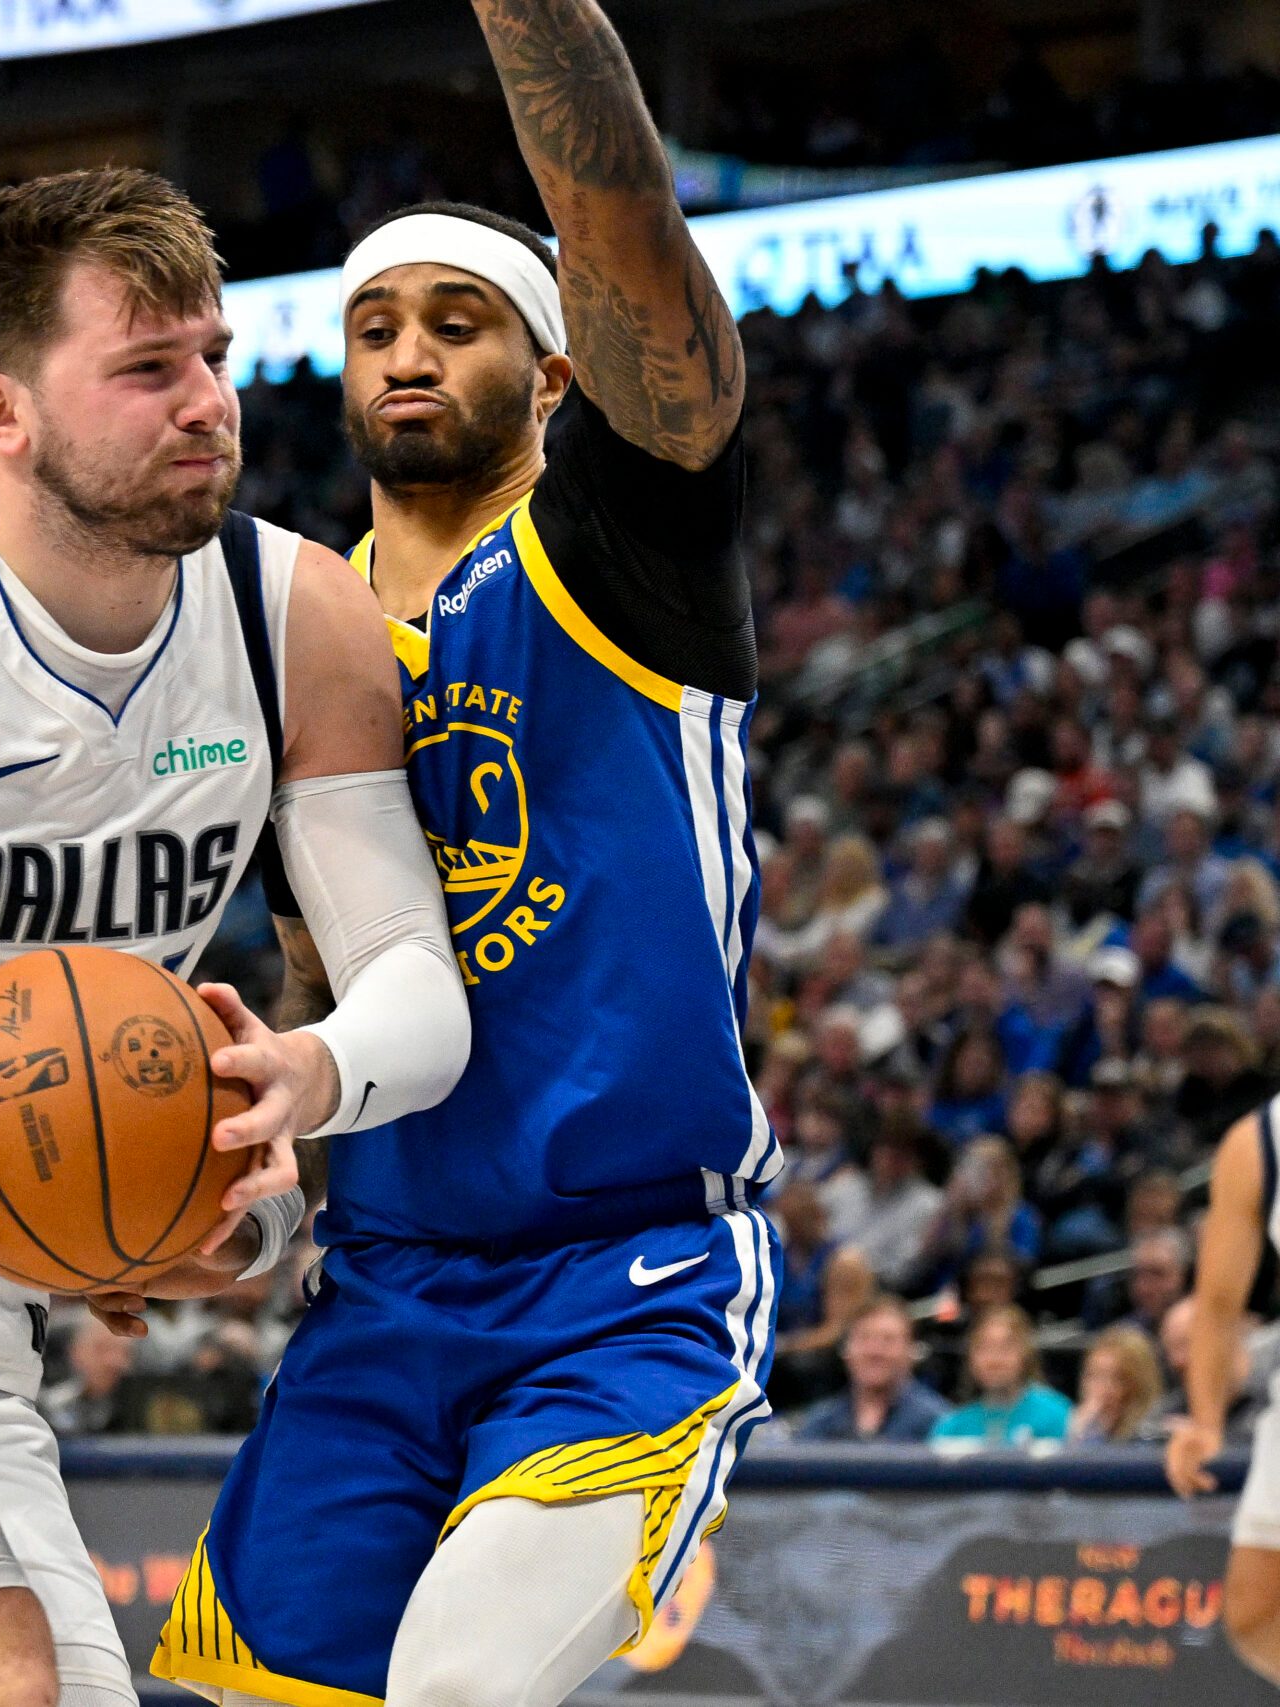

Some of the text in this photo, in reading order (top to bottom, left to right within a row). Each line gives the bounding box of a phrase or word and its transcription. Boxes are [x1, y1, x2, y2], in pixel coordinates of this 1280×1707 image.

[438, 549, 512, 617] Rakuten
[444, 682, 523, 724] TATE
[153, 737, 248, 776] chime
[461, 875, 566, 986] IORS
[961, 1574, 1224, 1628] THERAGU
